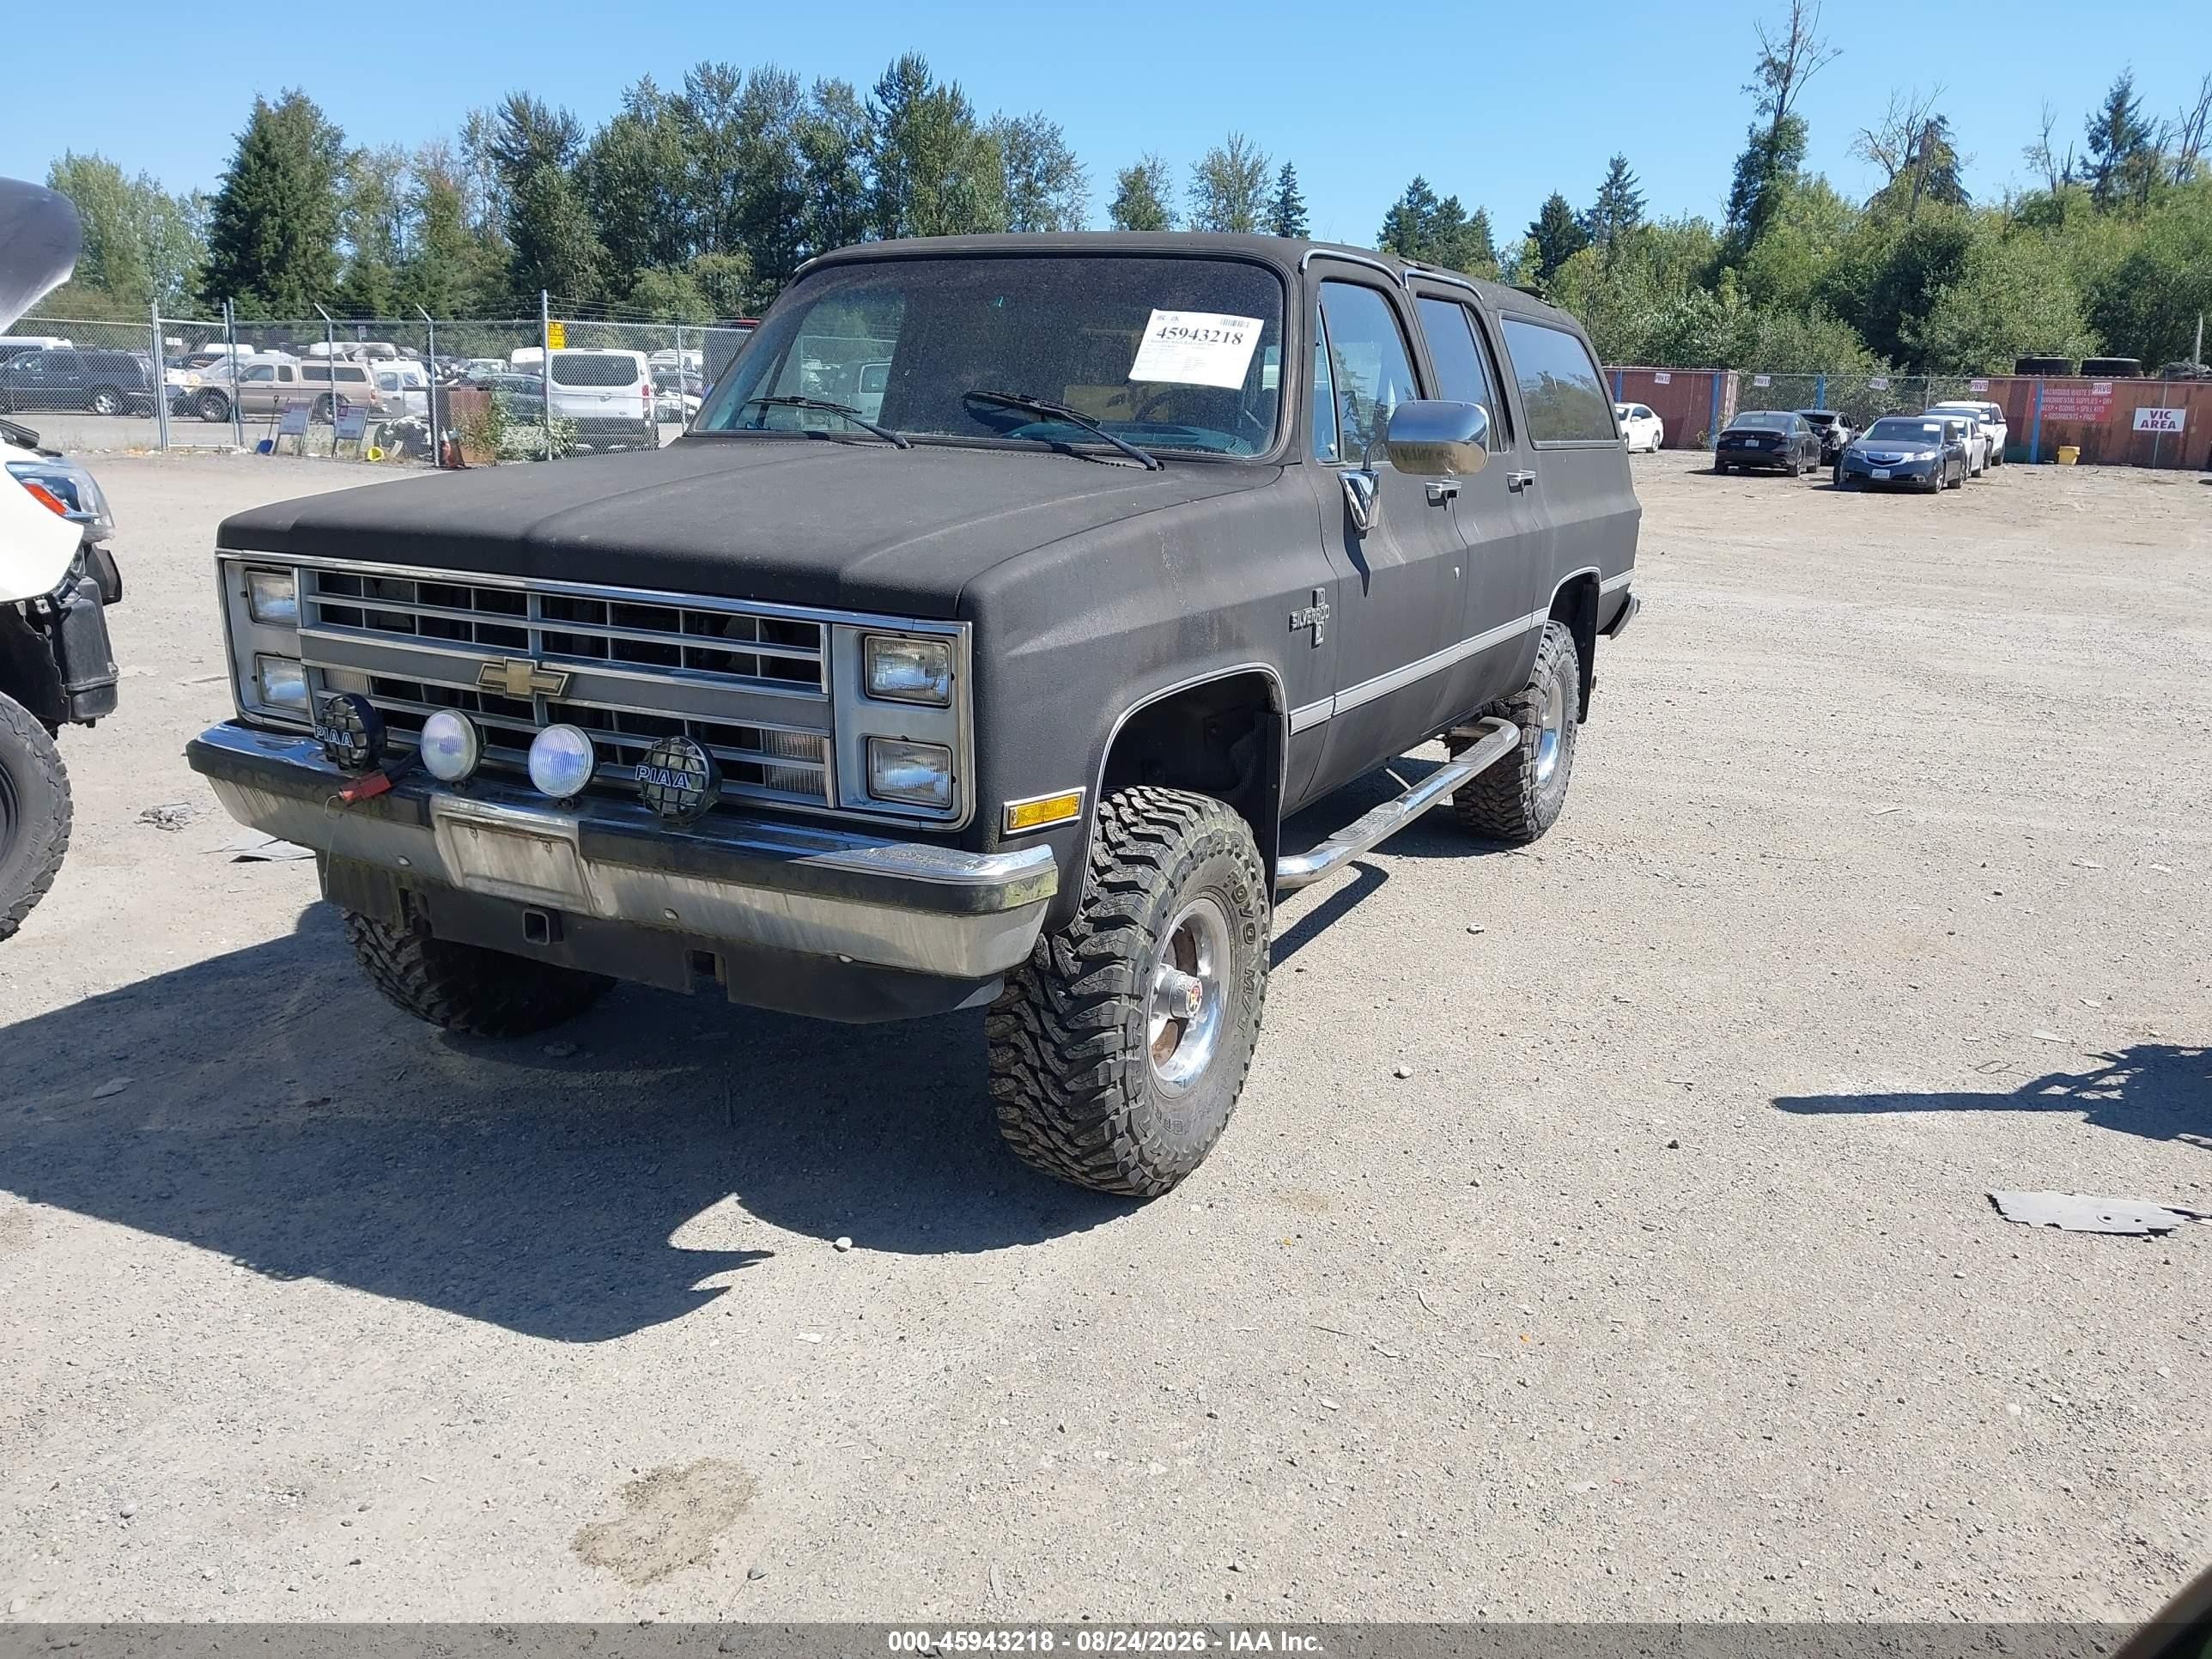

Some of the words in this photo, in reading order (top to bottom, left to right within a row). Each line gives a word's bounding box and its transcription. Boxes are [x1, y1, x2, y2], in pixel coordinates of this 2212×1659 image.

[1156, 326, 1243, 345] 45943218
[2093, 384, 2111, 392] PRV8
[2140, 419, 2176, 429] AREA
[2149, 410, 2172, 419] VIC
[1289, 605, 1330, 632] SILVERADO
[314, 724, 354, 748] PIAA
[635, 764, 690, 789] PIAA
